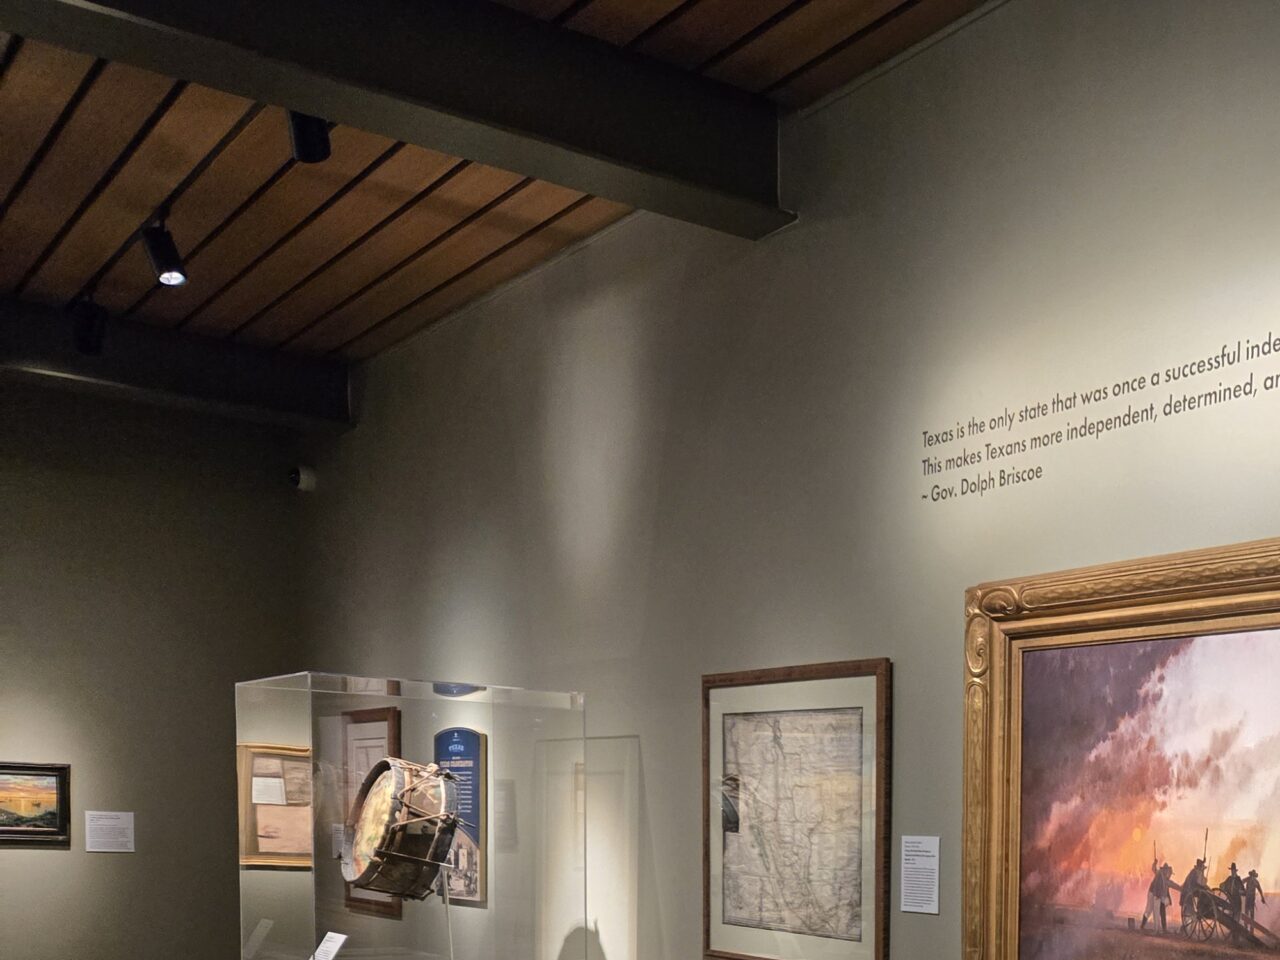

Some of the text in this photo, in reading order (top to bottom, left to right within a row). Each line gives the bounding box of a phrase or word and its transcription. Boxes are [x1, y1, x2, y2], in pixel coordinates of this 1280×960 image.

[922, 430, 953, 448] Texas
[956, 422, 965, 439] is
[968, 417, 986, 436] the
[989, 407, 1015, 431] only
[1019, 402, 1048, 423] state
[1052, 392, 1077, 414] that
[1080, 386, 1108, 405] was
[1112, 376, 1146, 397] once
[1150, 371, 1160, 387] a
[1164, 341, 1241, 383] successful
[922, 457, 942, 476] This
[945, 448, 982, 471] makes
[985, 439, 1027, 461] Texans
[1030, 430, 1063, 450] more
[1066, 403, 1157, 441] independent,
[1162, 372, 1257, 417] determined,
[931, 484, 958, 502] Gov.
[961, 471, 995, 497] Dolph
[999, 465, 1043, 487] Briscoe
